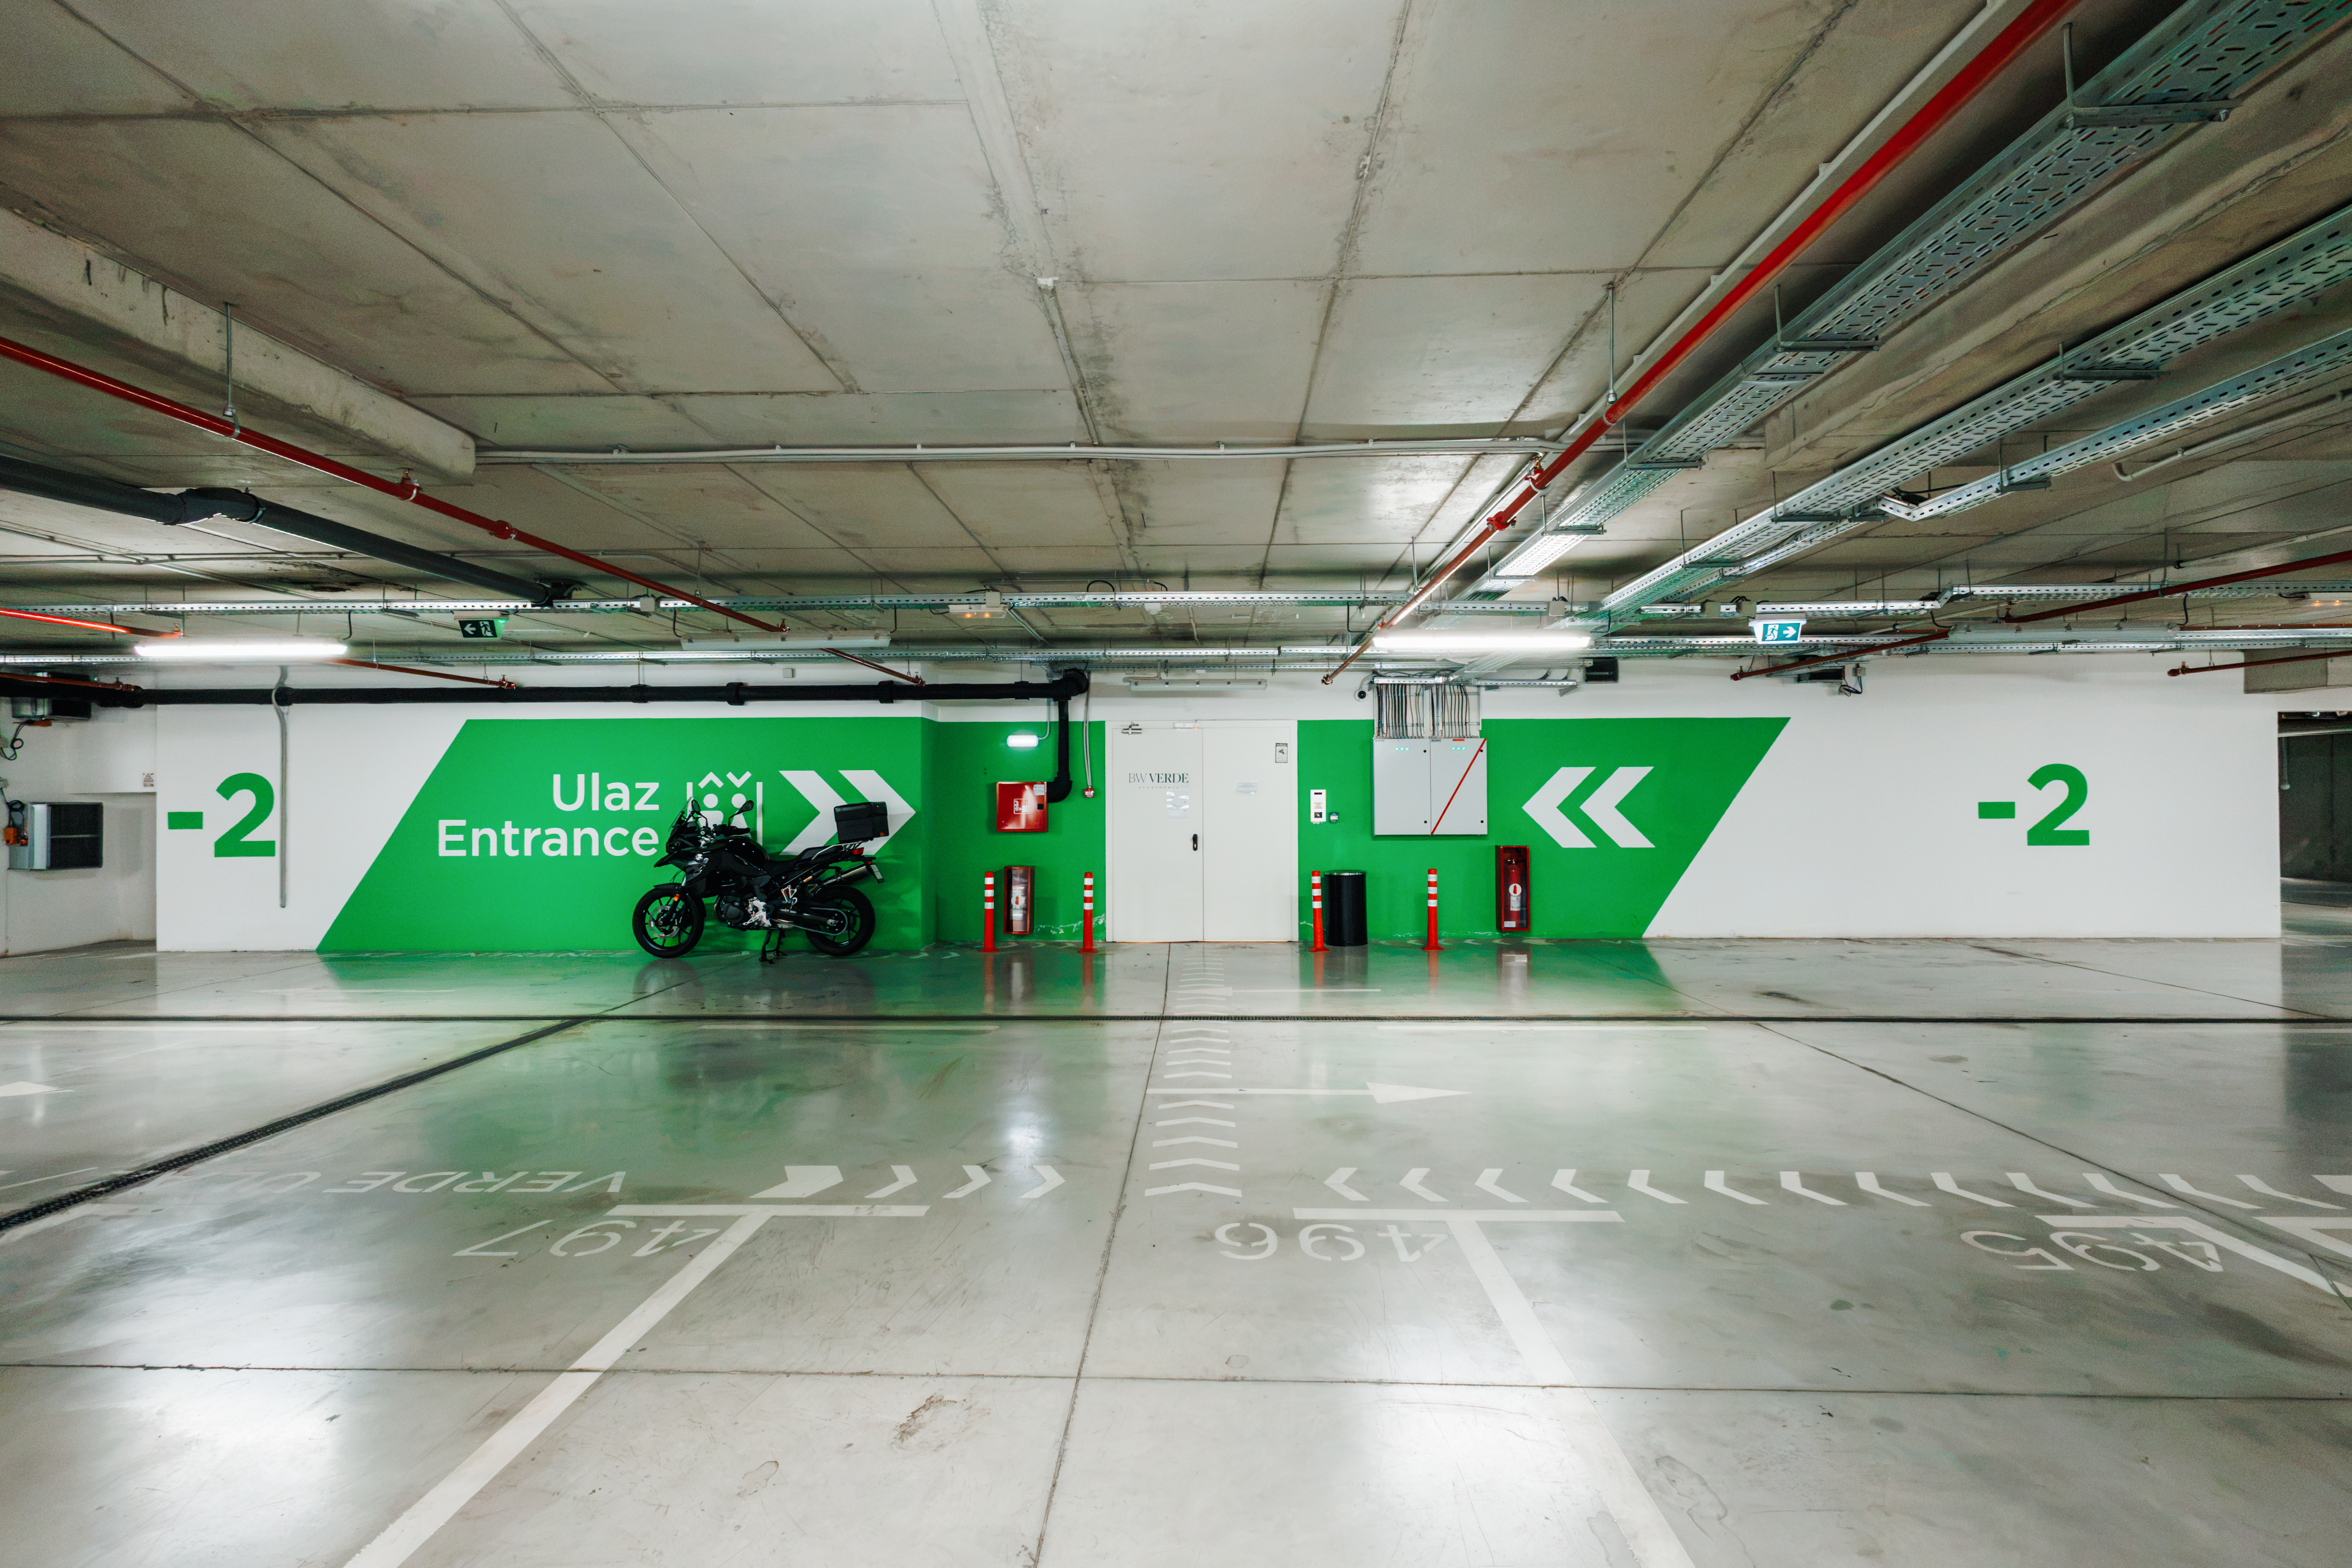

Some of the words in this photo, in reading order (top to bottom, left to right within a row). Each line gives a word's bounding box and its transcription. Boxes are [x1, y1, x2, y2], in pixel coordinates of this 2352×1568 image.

[552, 772, 659, 812] Ulaz
[1129, 773, 1147, 783] BW
[1149, 773, 1189, 783] VERDE
[168, 772, 276, 858] -2
[1978, 764, 2090, 846] -2
[438, 819, 659, 857] Entrance
[322, 1171, 627, 1193] VERDE
[451, 1219, 721, 1257] 497
[1215, 1222, 1448, 1262] 496
[1960, 1230, 2224, 1272] 495
